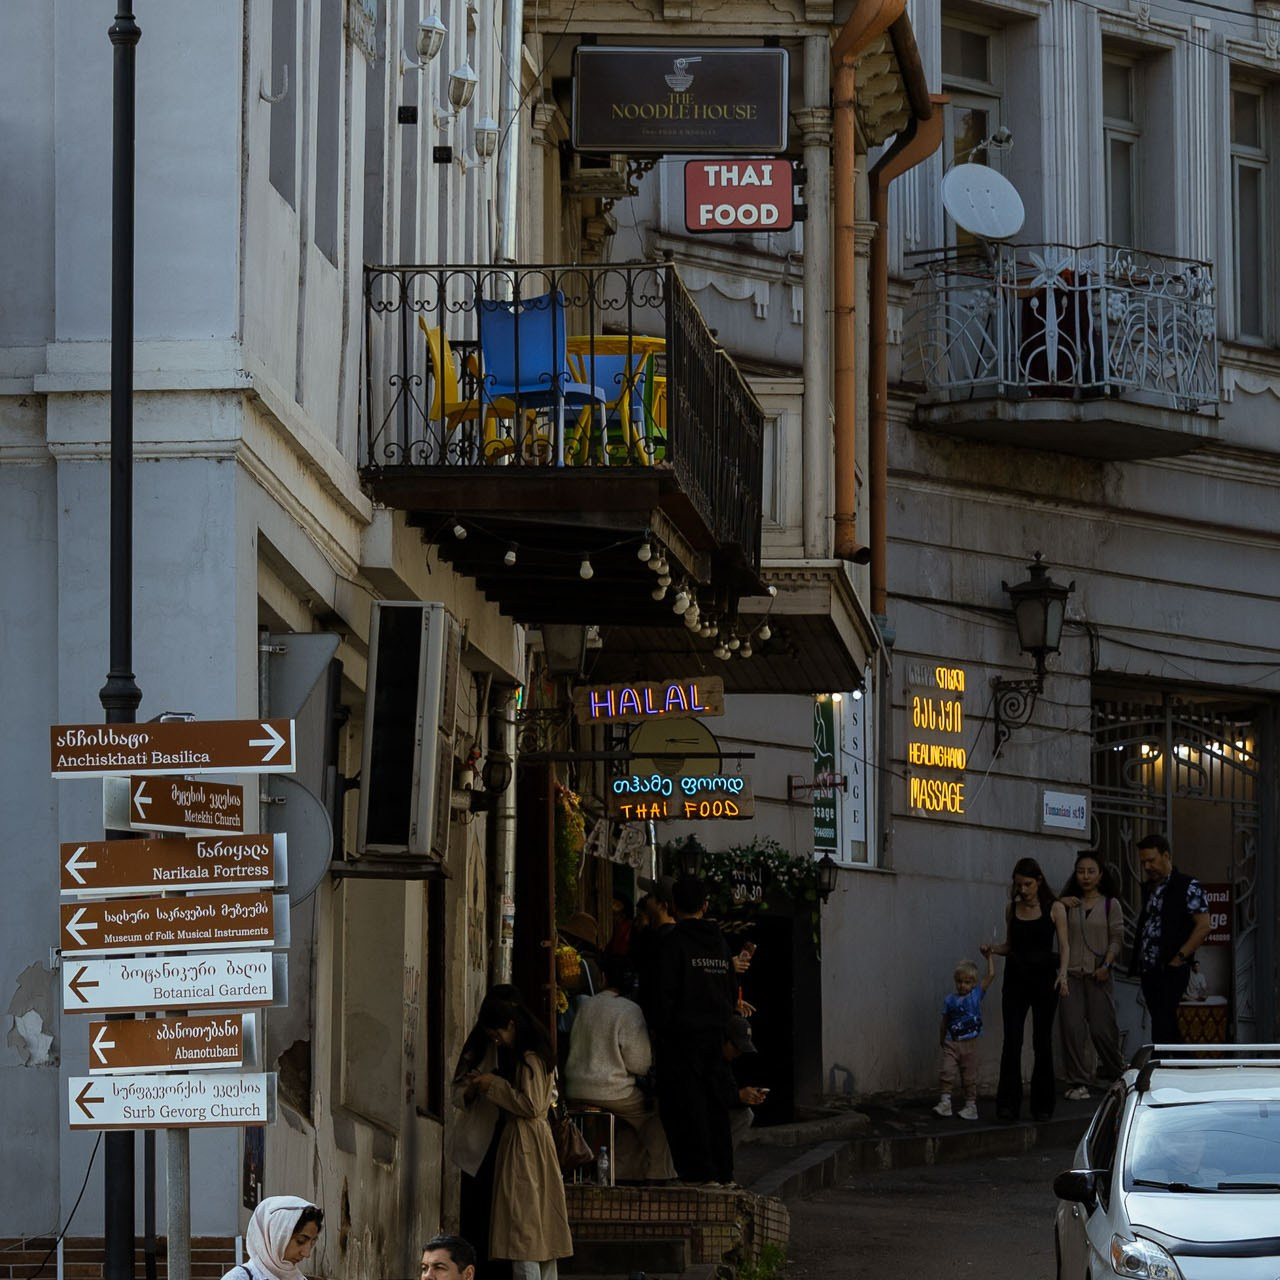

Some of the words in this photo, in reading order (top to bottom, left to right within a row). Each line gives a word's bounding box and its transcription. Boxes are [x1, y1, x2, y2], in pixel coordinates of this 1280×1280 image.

[667, 92, 695, 105] THE
[611, 103, 690, 120] NOODLE
[693, 104, 758, 120] HOUSE
[703, 165, 773, 187] THAI
[699, 204, 779, 226] FOOD
[590, 683, 709, 718] HALAL
[56, 729, 150, 750] ანჩისხატი
[56, 752, 147, 767] Anchiskhati
[151, 750, 210, 765] Basilica
[851, 698, 861, 824] SSAGE
[910, 777, 965, 814] MASSAGE
[184, 809, 213, 824] Metekhi
[214, 812, 241, 826] Church
[684, 800, 740, 818] FOOD
[196, 841, 270, 866] ნარიყალა
[152, 865, 210, 881] Narikala
[214, 863, 270, 878] Fortress
[156, 905, 216, 923] საკრავების
[104, 931, 142, 944] Museum
[145, 931, 155, 942] of
[155, 929, 175, 941] Folk
[177, 928, 213, 940] Musical
[214, 926, 269, 938] Instruments
[120, 960, 217, 984] ბოტანიკური
[153, 984, 215, 1000] Botanical
[218, 982, 268, 998] Garden
[156, 1019, 239, 1043] აბანოთუბანი
[174, 1044, 239, 1060] Abanotubani
[212, 1080, 261, 1098] ეკლესია
[123, 1106, 156, 1119] Surb
[159, 1105, 207, 1121] Gevorg
[210, 1103, 260, 1117] Church
